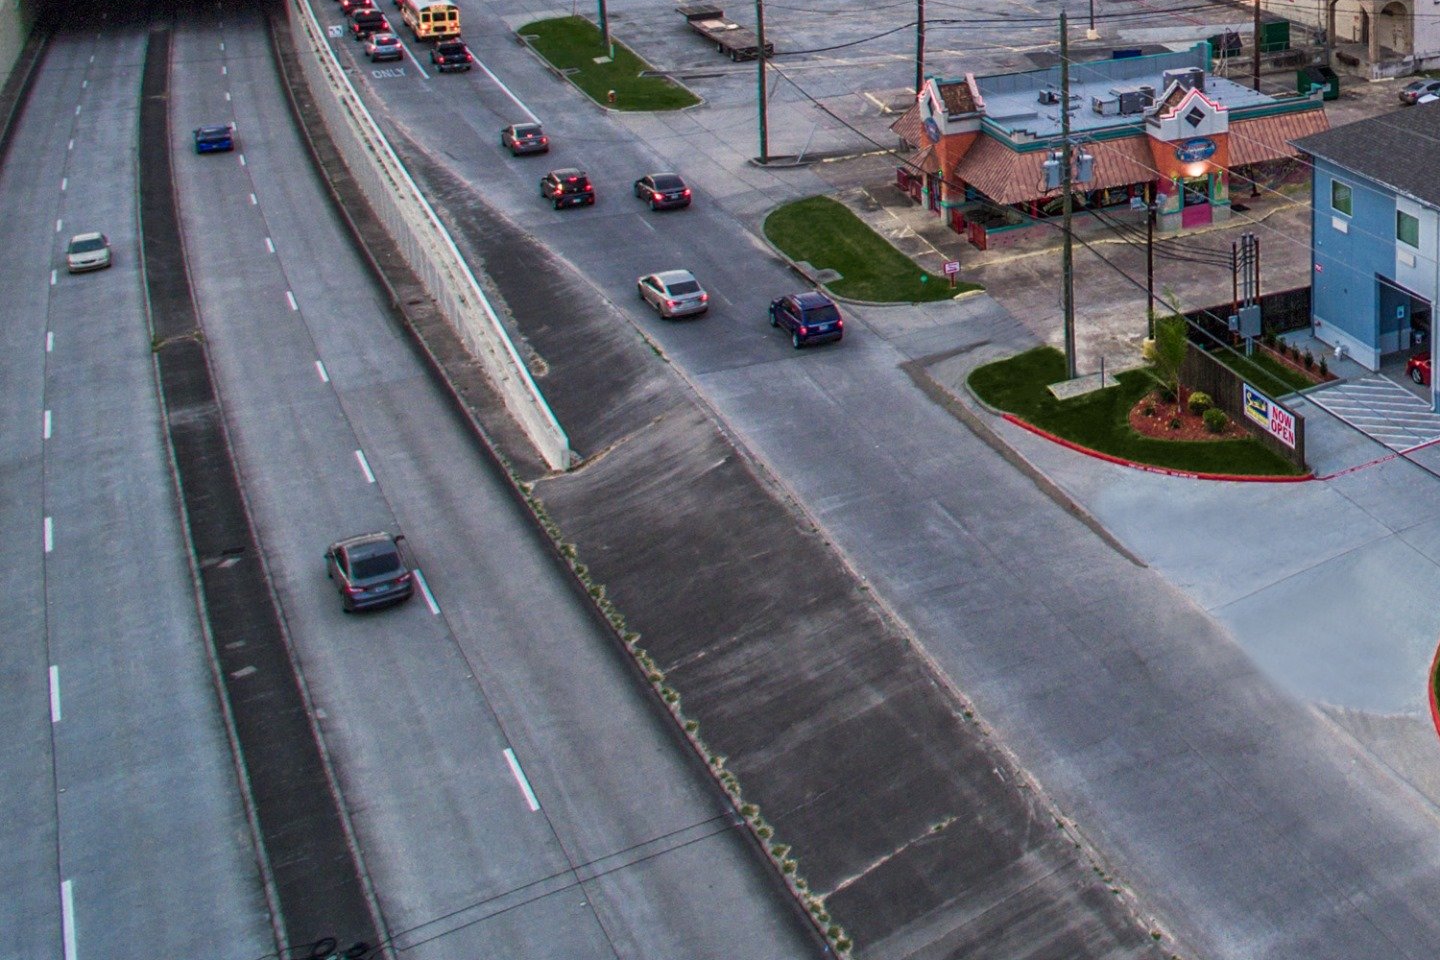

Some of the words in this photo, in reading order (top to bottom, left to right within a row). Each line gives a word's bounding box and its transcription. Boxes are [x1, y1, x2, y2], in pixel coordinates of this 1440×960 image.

[371, 68, 405, 79] ONLY
[1272, 406, 1292, 429] NOW
[1271, 419, 1294, 445] OPEN
